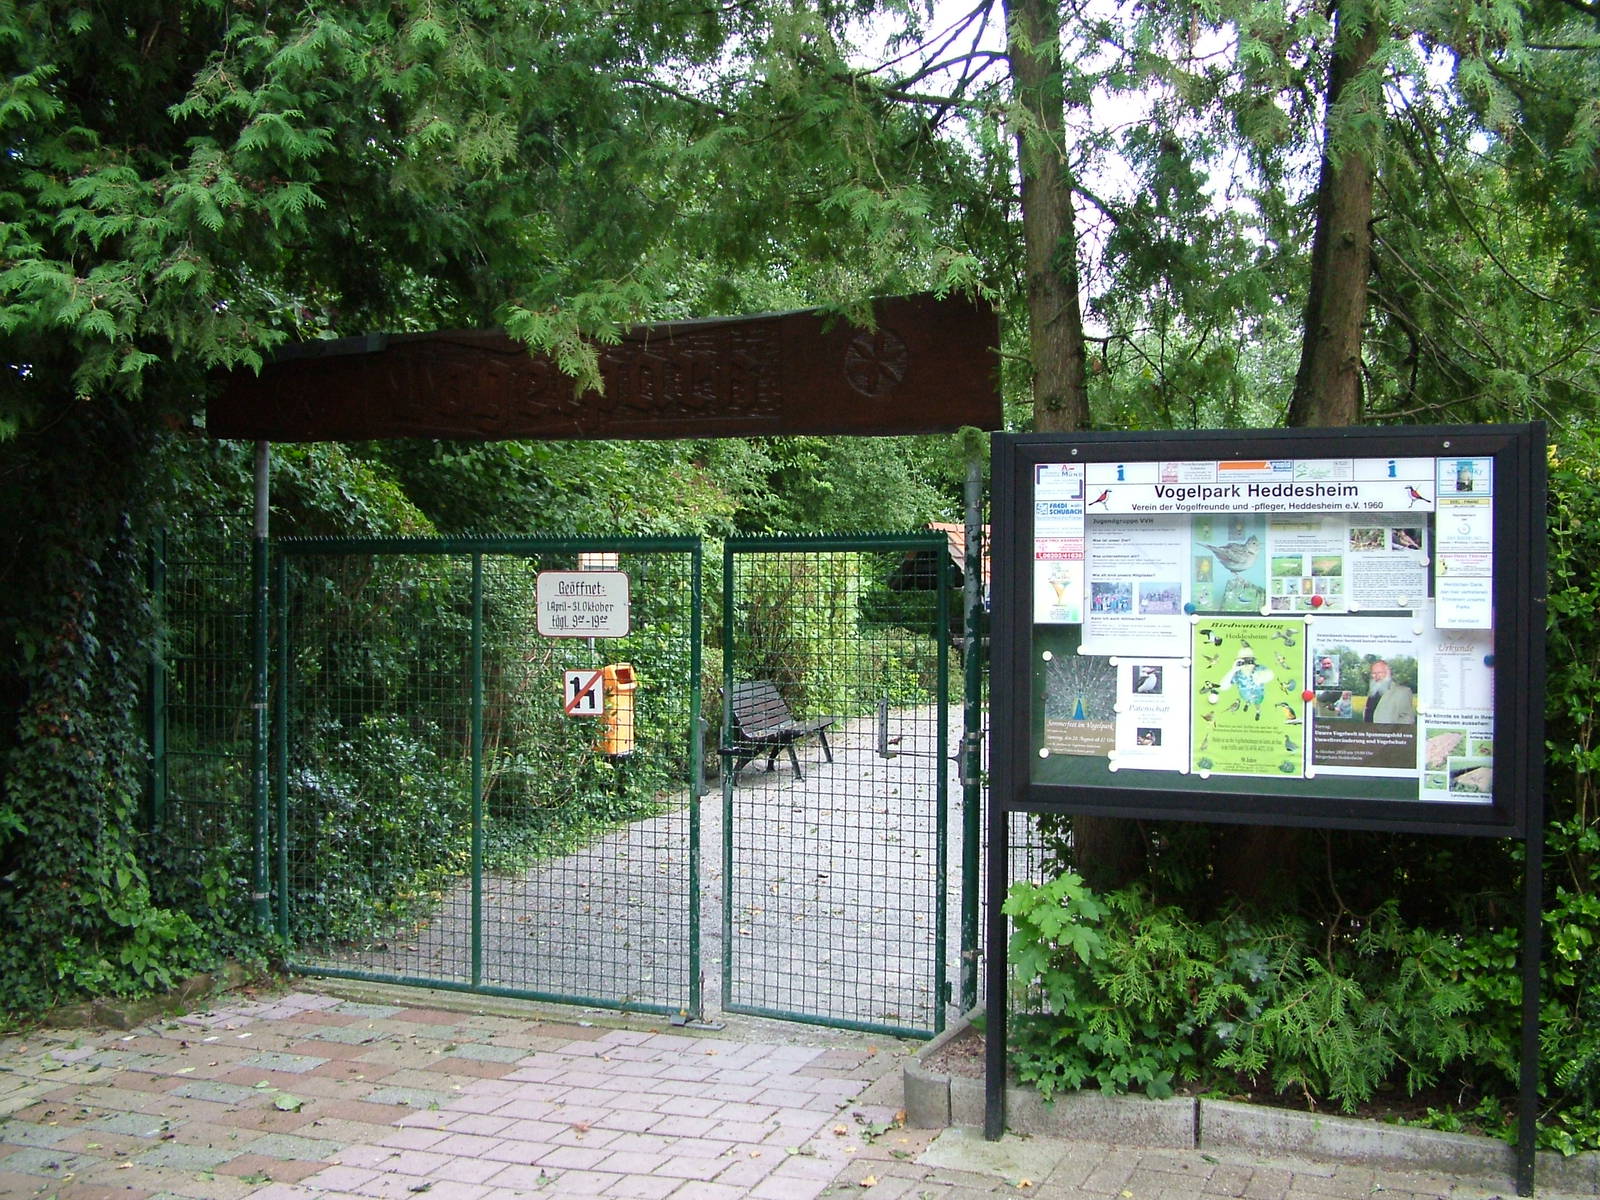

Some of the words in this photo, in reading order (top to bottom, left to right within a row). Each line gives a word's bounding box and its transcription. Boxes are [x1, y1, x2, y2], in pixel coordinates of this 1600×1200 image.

[1154, 484, 1241, 501] Vogelpark
[1248, 482, 1359, 497] Heddesheim
[1131, 503, 1157, 511] Verein
[1159, 503, 1173, 511] der
[1175, 503, 1229, 512] Vogelfreunde
[1232, 503, 1249, 511] und
[1288, 502, 1343, 511] Heddesheim
[1345, 501, 1360, 510] e.V.
[1363, 501, 1384, 510] 1960
[558, 580, 606, 595] Geöffnet:
[1210, 622, 1284, 630] Birdwatching
